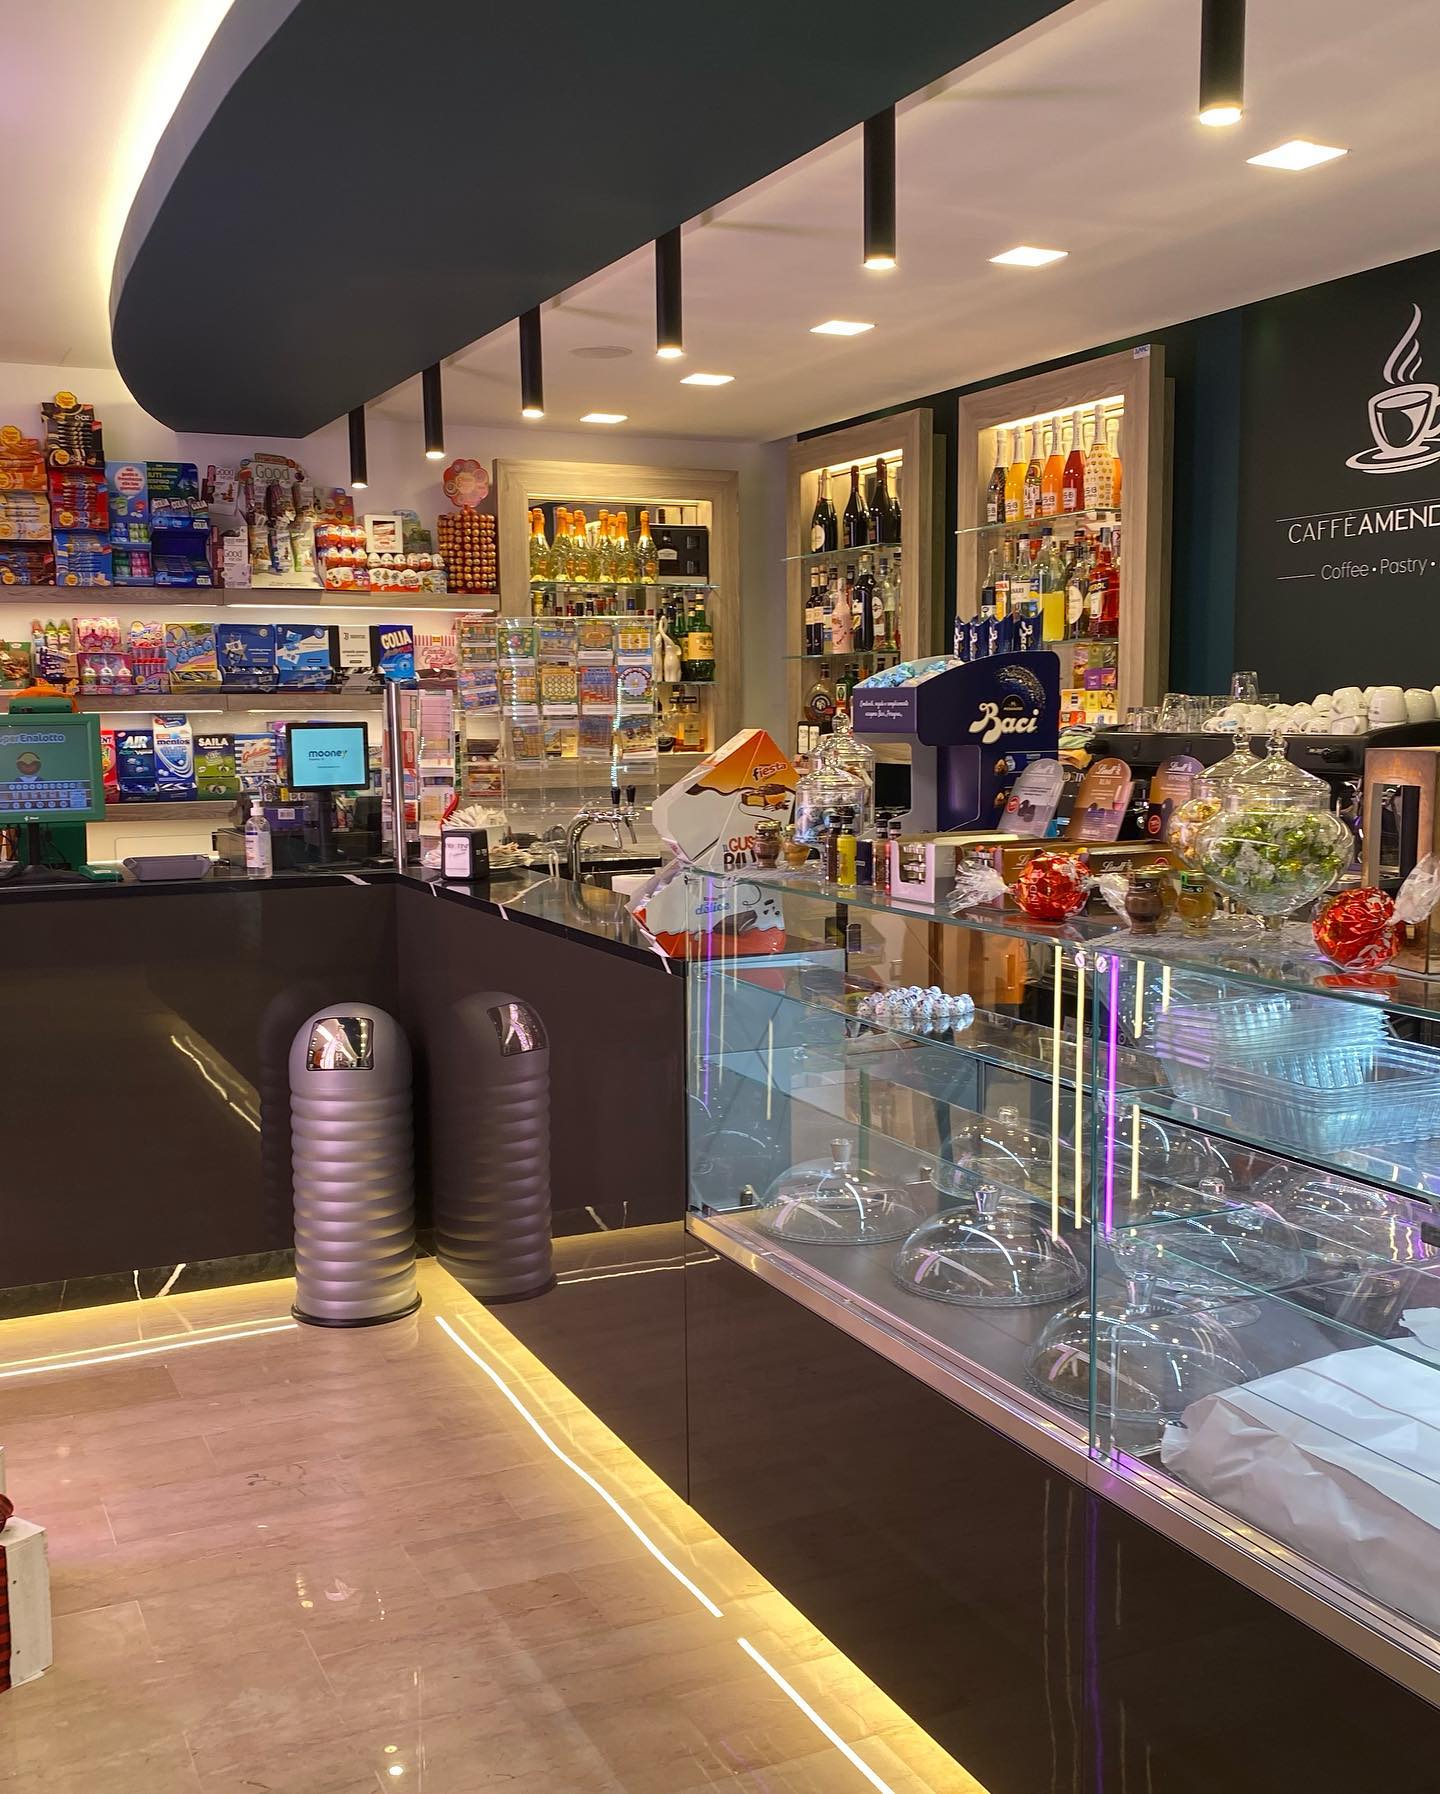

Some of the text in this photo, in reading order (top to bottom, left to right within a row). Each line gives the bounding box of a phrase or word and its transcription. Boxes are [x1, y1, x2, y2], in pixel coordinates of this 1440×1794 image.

[1321, 557, 1428, 580] Coffee Pastry
[968, 702, 1039, 744] Baci
[123, 736, 148, 748] AIR
[198, 737, 229, 747] SAILA
[309, 750, 348, 760] mooney
[753, 762, 787, 781] fiesta
[729, 835, 754, 852] GUS
